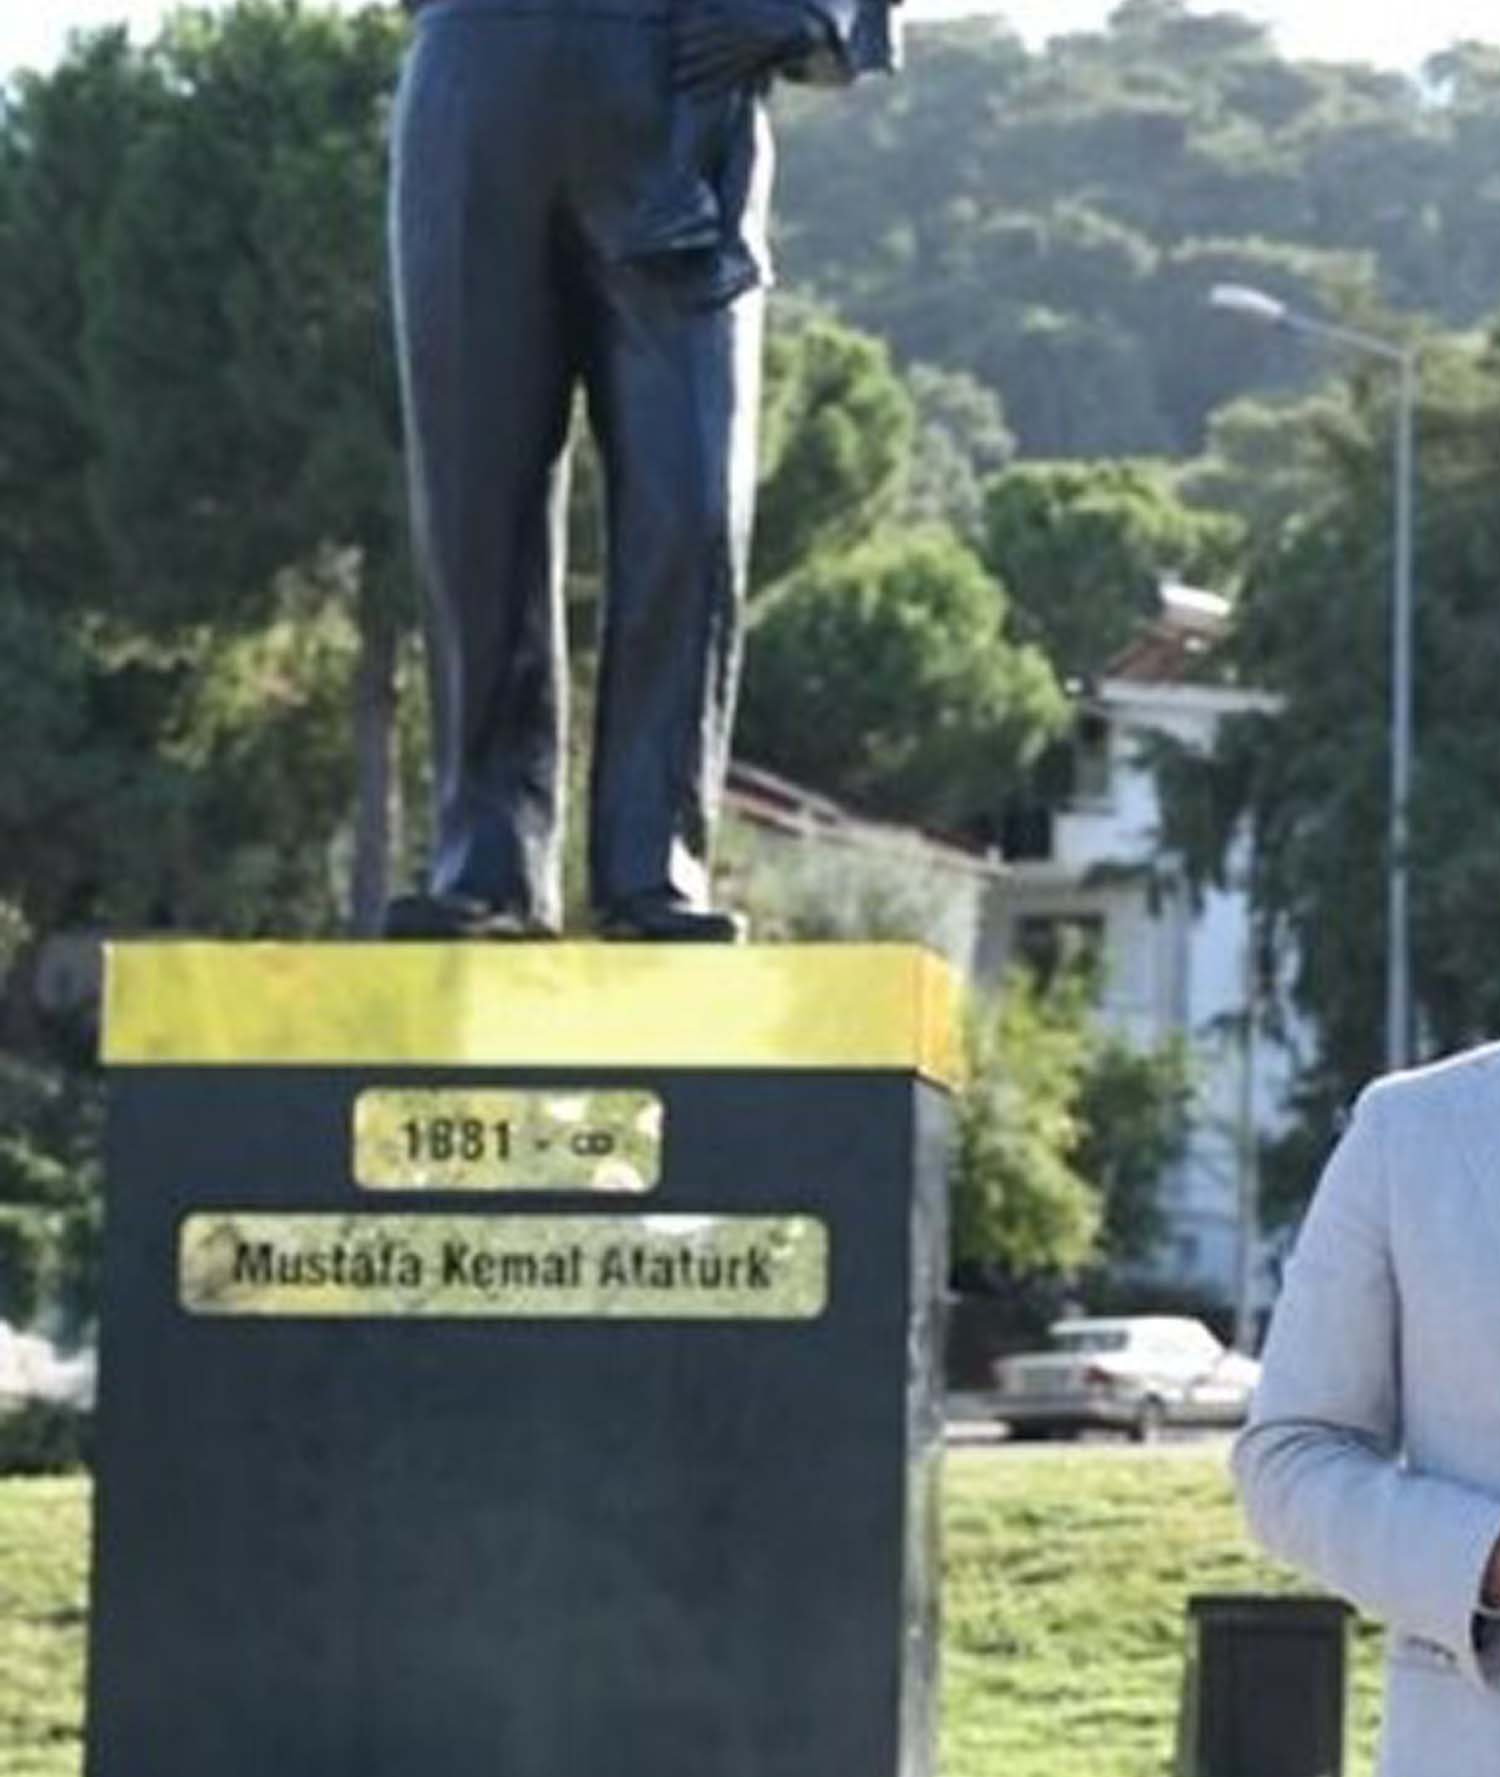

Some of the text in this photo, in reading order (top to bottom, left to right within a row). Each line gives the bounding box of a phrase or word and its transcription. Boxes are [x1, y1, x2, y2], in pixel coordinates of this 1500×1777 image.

[402, 1119, 510, 1160] 1881
[234, 1239, 422, 1288] Mustafa
[442, 1242, 581, 1288] Kemal
